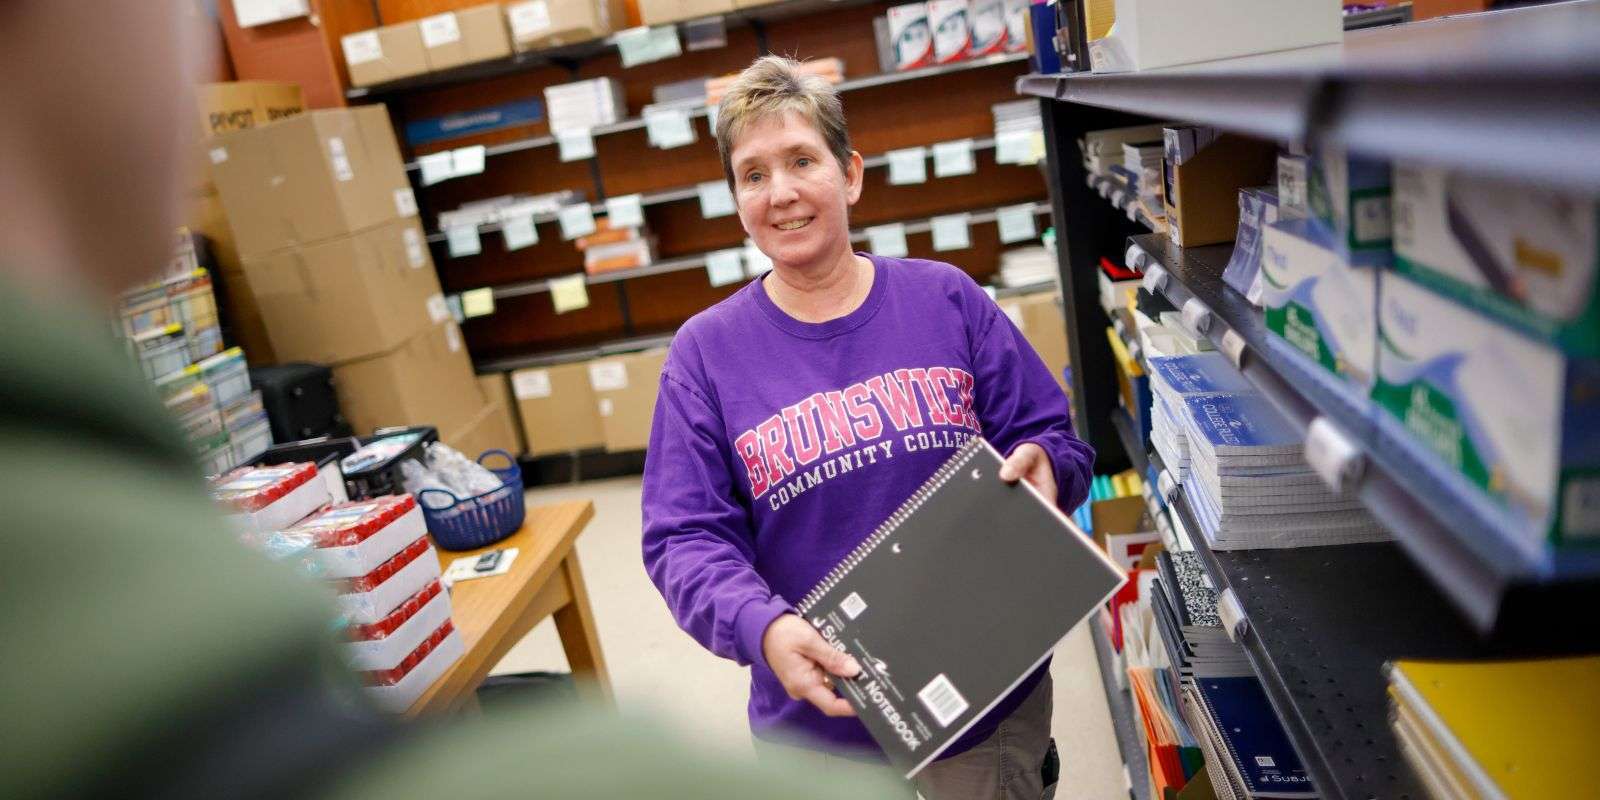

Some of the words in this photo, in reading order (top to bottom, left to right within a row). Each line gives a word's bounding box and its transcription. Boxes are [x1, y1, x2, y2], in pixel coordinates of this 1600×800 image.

[734, 366, 981, 500] BRUNSWICK
[769, 440, 893, 512] COMMUNITY
[904, 430, 977, 452] COLLEG
[865, 680, 921, 751] NOTEBOOK
